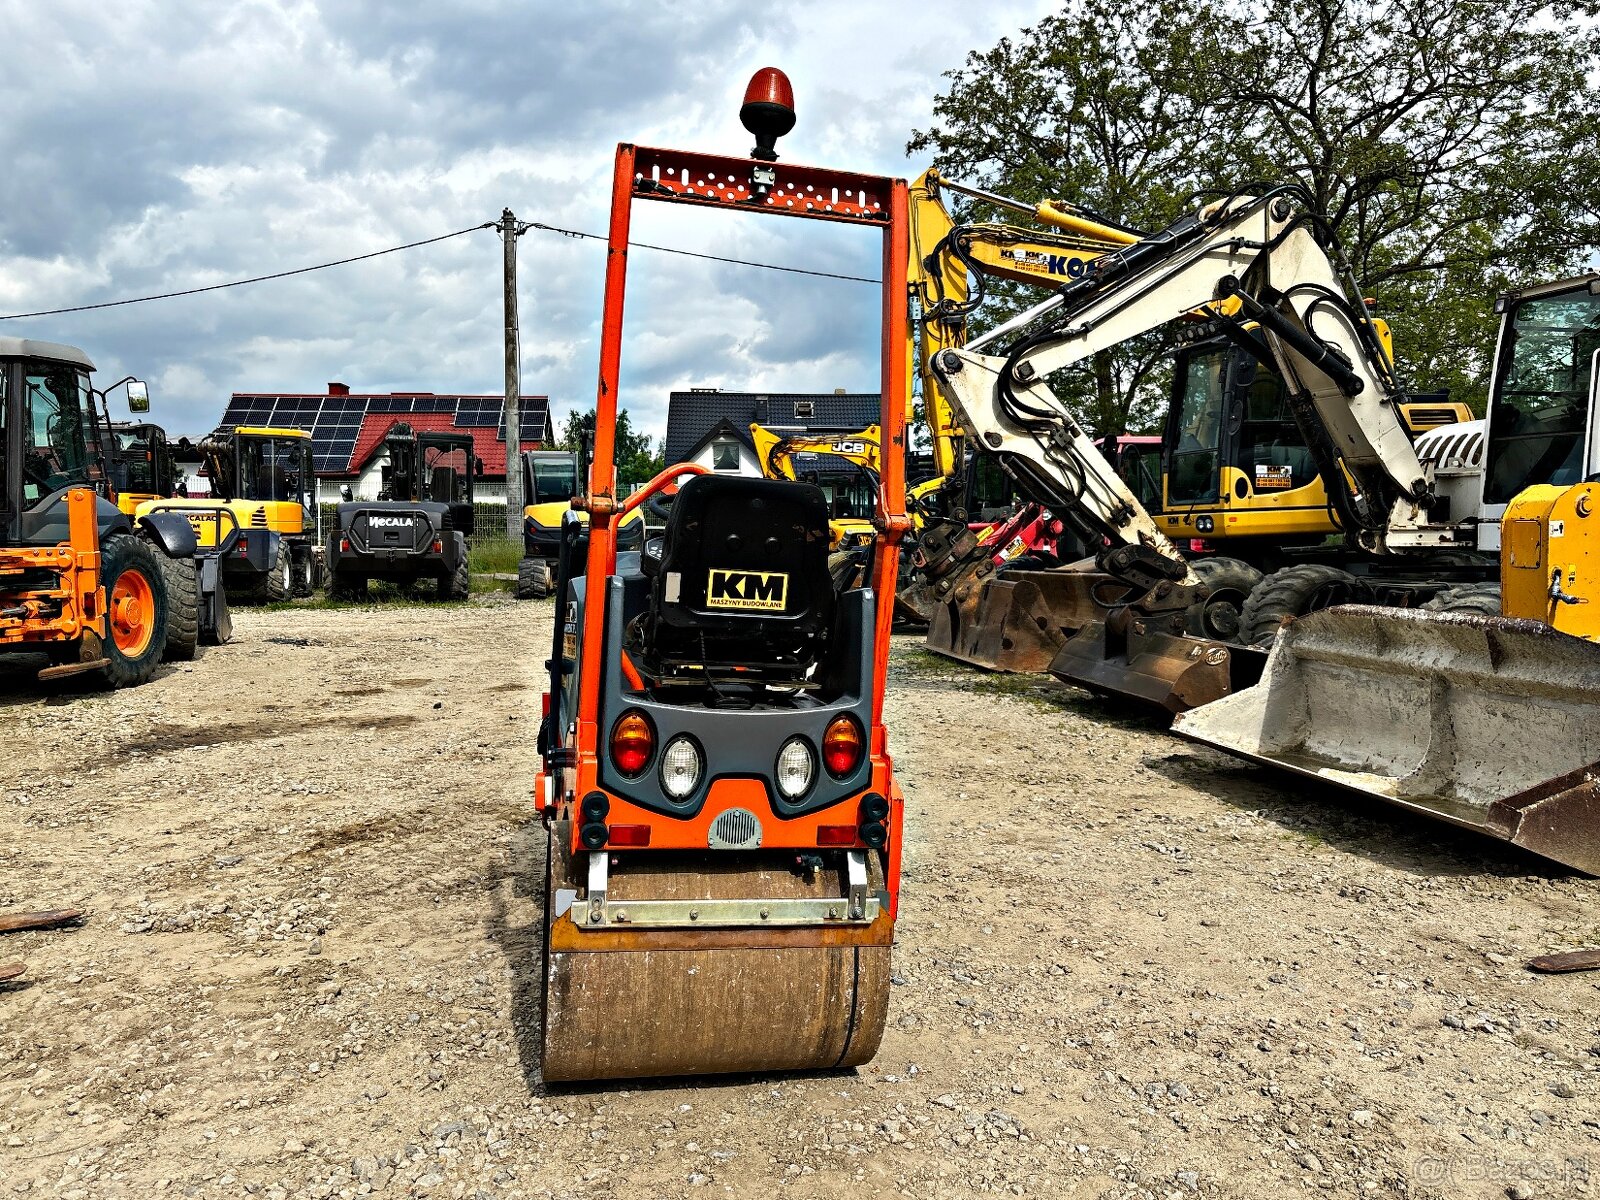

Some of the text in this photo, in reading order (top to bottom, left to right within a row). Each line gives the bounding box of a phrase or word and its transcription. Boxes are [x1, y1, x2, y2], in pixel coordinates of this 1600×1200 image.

[832, 442, 865, 453] JCB
[1168, 517, 1179, 525] KM
[711, 572, 785, 601] KM
[742, 600, 782, 608] BUDOWLANE
